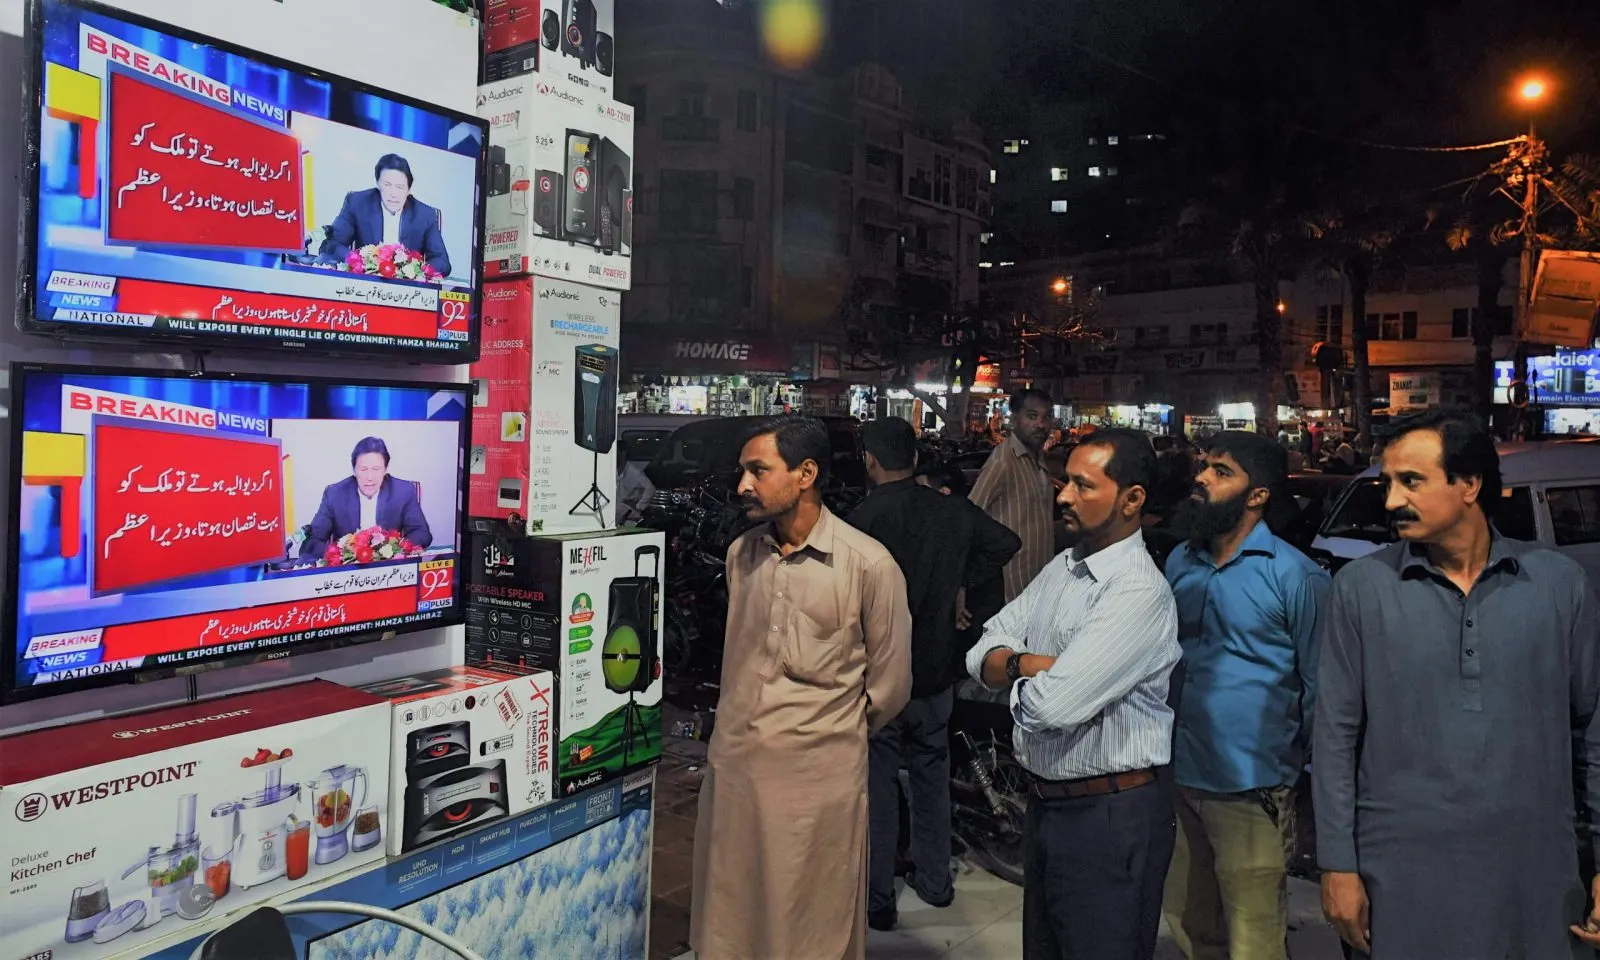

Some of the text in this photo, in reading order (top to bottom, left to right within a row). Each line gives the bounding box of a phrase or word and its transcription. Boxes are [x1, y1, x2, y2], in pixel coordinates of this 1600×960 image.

[88, 33, 284, 120] BREAKING NEWS
[488, 85, 524, 100] Audionic
[550, 86, 584, 106] Audionic
[130, 123, 156, 146] کو
[150, 133, 186, 156] ملک
[186, 137, 199, 158] تو
[273, 160, 291, 181] اگر
[275, 208, 297, 224] بہت
[589, 264, 601, 276] DUAL
[52, 276, 111, 290] BREAKING
[62, 294, 100, 307] NEWS
[487, 288, 518, 298] Audionic
[550, 288, 579, 300] Audionic
[69, 311, 144, 325] NATIONAL
[442, 300, 466, 327] 92
[566, 313, 595, 322] WIRELESS
[168, 319, 195, 330] WILL
[198, 322, 237, 332] EXPOSE
[241, 325, 271, 335] EVERY
[274, 328, 306, 338] SINGLE
[339, 333, 396, 345] GOVERNMENT:
[398, 338, 424, 347] HAMZA
[426, 340, 459, 349] SHAHBAZ
[555, 320, 608, 334] RECHARGEABLE
[493, 340, 523, 348] ADDRESS
[676, 342, 750, 360] HOMAGE
[1547, 351, 1594, 366] Haier
[70, 392, 265, 432] BREAKING NEWS
[117, 465, 143, 493] کو
[137, 468, 172, 492] ملک
[174, 471, 185, 492] تو
[258, 470, 272, 491] اگر
[258, 516, 278, 532] بہت
[425, 560, 449, 569] LIVE
[570, 546, 607, 568] MEHFIL
[422, 569, 450, 599] 92
[465, 583, 544, 601] PORTABLE SPEAKER
[490, 597, 512, 606] Wireless
[32, 634, 97, 652] BREAKING
[158, 654, 184, 663] WILL
[187, 645, 224, 659] EXPOSE
[226, 641, 255, 652] EVERY
[258, 636, 288, 647] SINGLE
[290, 633, 302, 642] LIE
[318, 623, 373, 637] GOVERNMENT:
[375, 616, 402, 628] HAMZA
[405, 611, 442, 623] SHAHBAZ
[43, 652, 87, 667] NEWS
[268, 651, 290, 659] SONY
[51, 660, 133, 681] NATIONAL
[499, 702, 511, 721] EXTRA
[503, 690, 518, 716] WINNER
[139, 709, 252, 733] WESTPOINT
[528, 679, 550, 773] XTREME
[51, 761, 197, 810] WESTPOINT
[577, 774, 601, 788] Audionic
[589, 791, 612, 806] FRONT
[480, 832, 498, 844] SMART
[11, 850, 49, 866] Deluxe
[452, 845, 464, 855] HDR
[10, 847, 97, 882] Kitchen Chef
[399, 862, 438, 884] RESOLUTION
[413, 859, 426, 870] UHD
